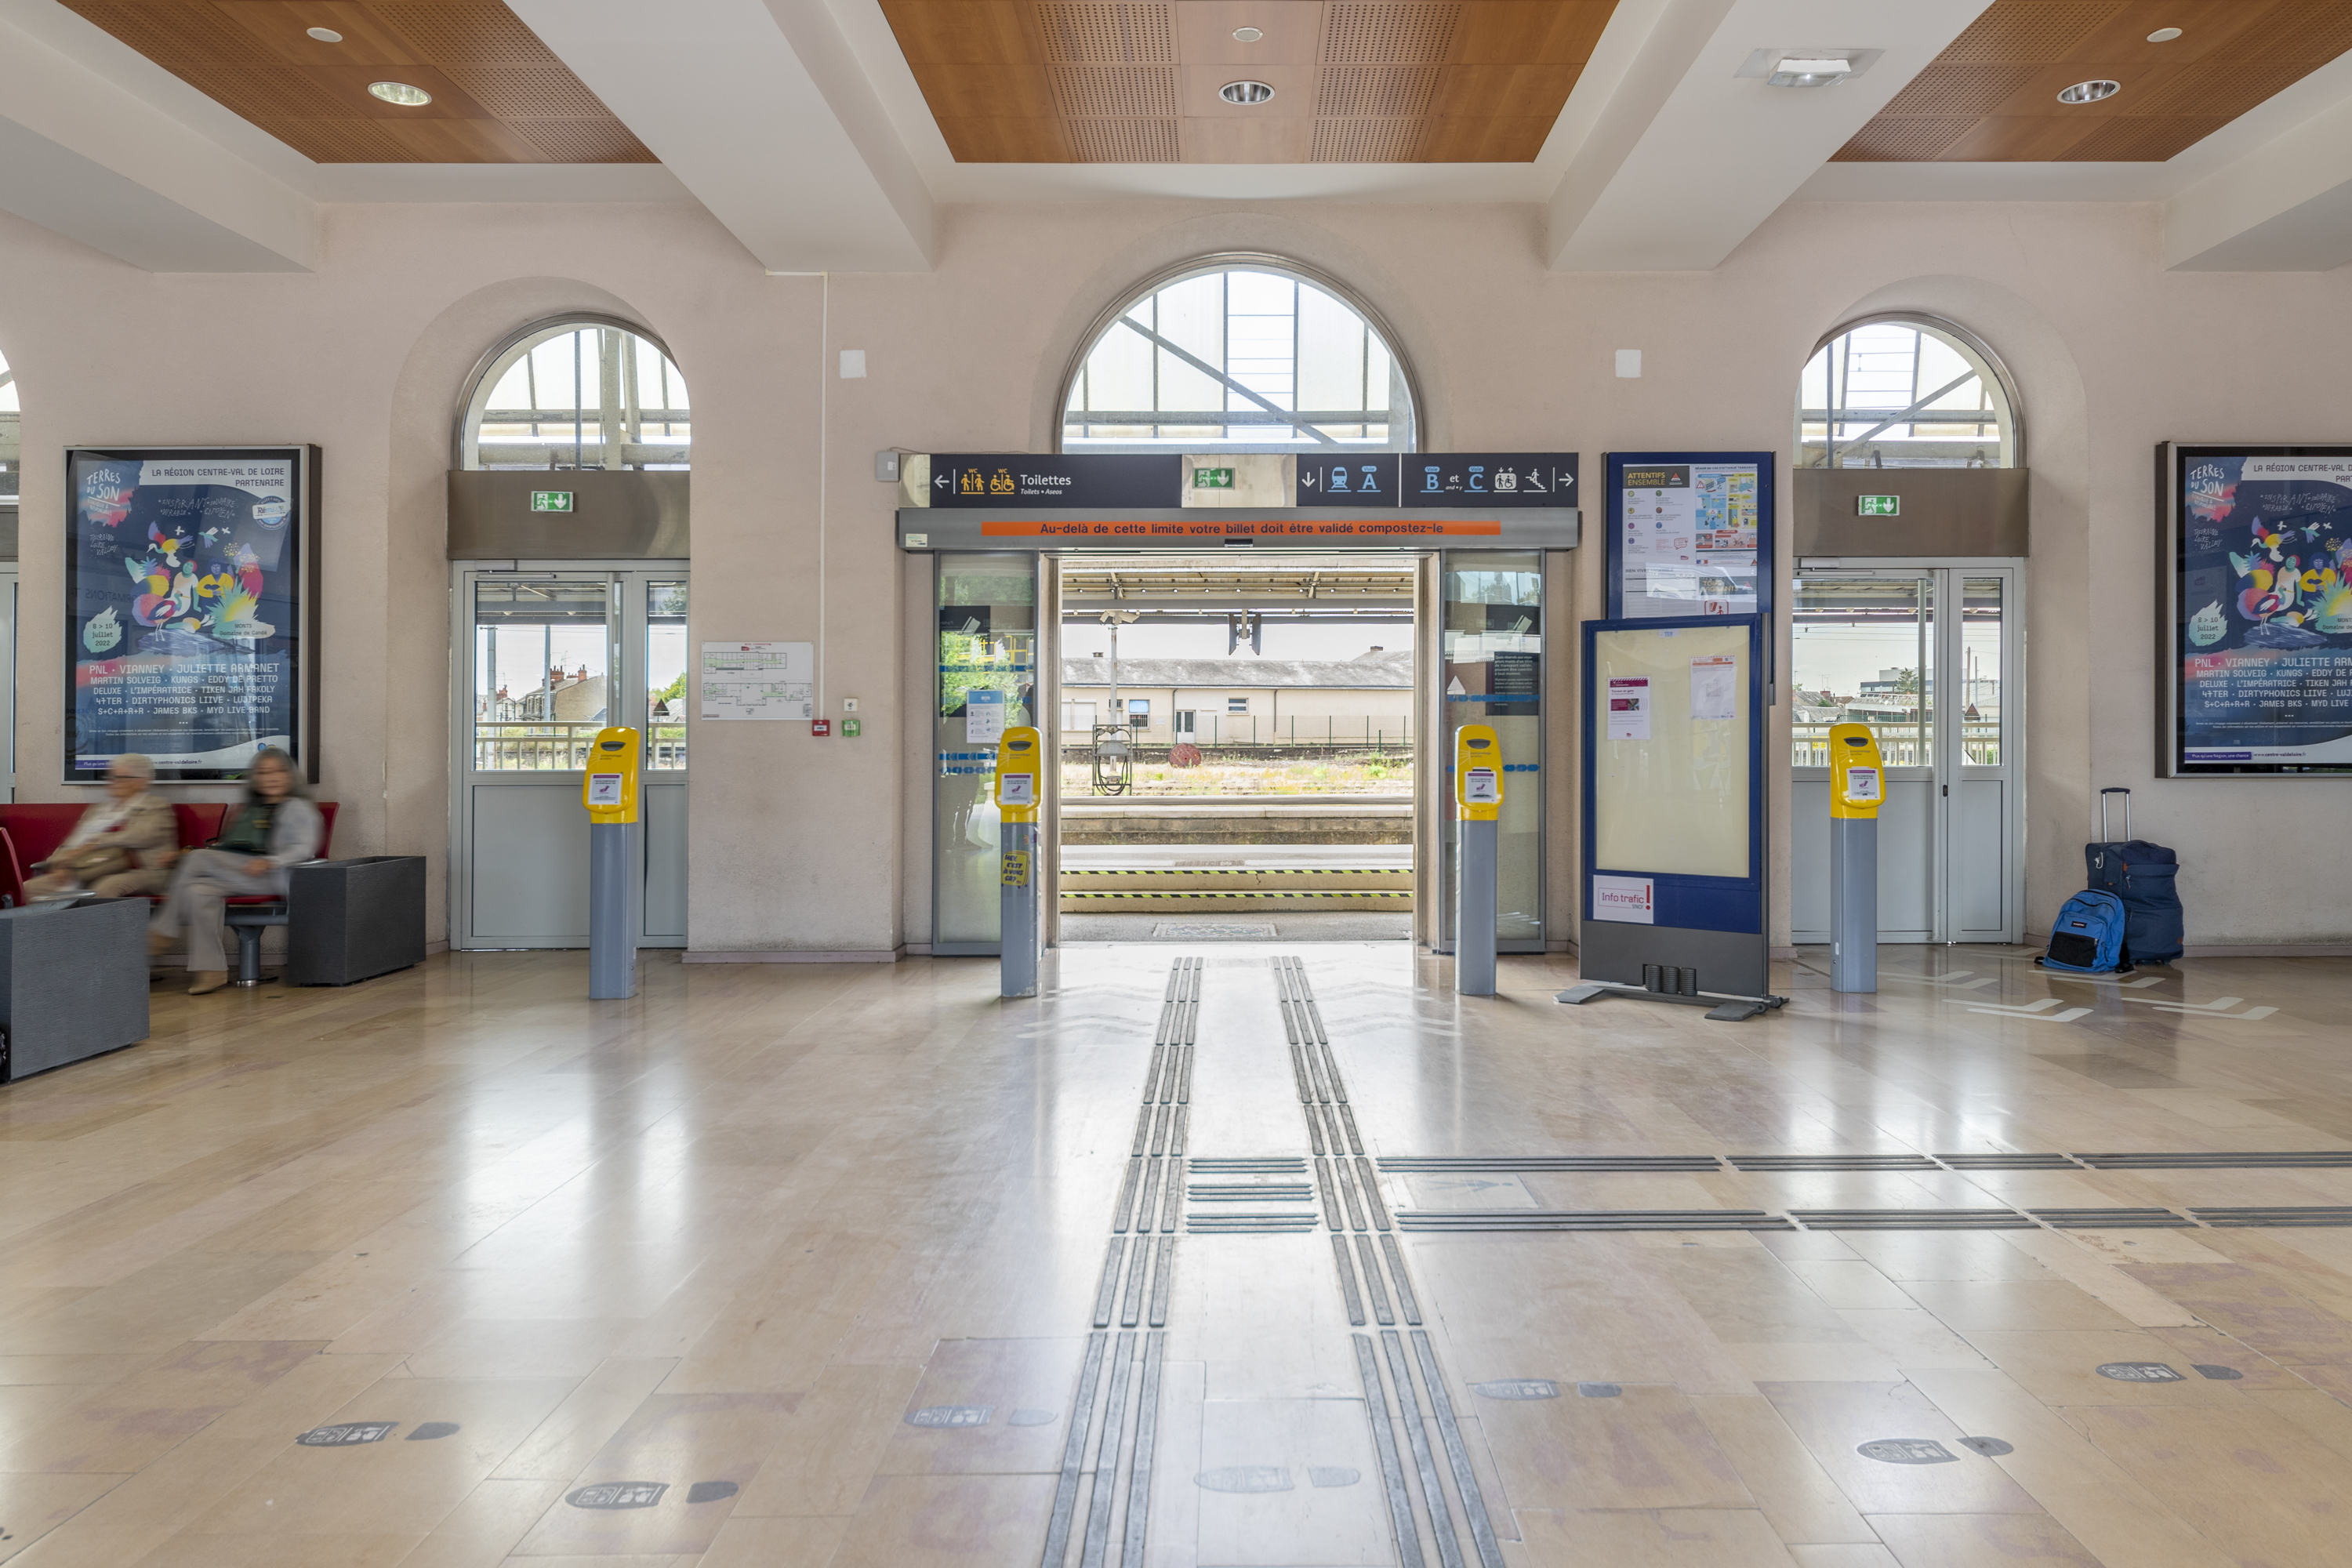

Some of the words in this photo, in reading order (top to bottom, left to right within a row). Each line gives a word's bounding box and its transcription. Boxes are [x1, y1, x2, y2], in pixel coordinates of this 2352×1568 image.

[164, 467, 194, 477] RÉGION
[2190, 463, 2224, 480] TERRES
[2267, 463, 2295, 472] RÉGION
[86, 468, 121, 485] TERRES
[1020, 474, 1071, 485] Toilettes
[1362, 474, 1377, 489] A
[1427, 474, 1439, 490] B
[1450, 474, 1459, 483] et
[1470, 474, 1483, 490] C
[86, 486, 96, 495] DU
[96, 484, 119, 501] SON
[2201, 478, 2223, 496] SON
[162, 497, 208, 510] INSPIRANT
[2264, 492, 2311, 505] INSPIRANT
[204, 507, 232, 519] CITOYEN
[2306, 503, 2334, 514] CITOYEN
[1040, 523, 1088, 534] Au-delà
[1094, 523, 1109, 534] de
[1114, 524, 1146, 534] cette
[1152, 524, 1184, 534] limite
[1190, 524, 1221, 534] votre
[1225, 523, 1255, 534] billet
[1261, 523, 1283, 533] doit
[1290, 523, 1313, 533] être
[1319, 523, 1353, 533] validé
[1359, 523, 1443, 535] compostez-le
[89, 665, 108, 674] PNL
[119, 664, 165, 674] VIANNEY
[176, 663, 227, 673] JULIETTE
[230, 663, 280, 673] ARMANET
[2195, 659, 2214, 667] PNL
[2226, 658, 2270, 667] VIANNEY
[2281, 658, 2330, 666] JULIETTE
[126, 676, 162, 684] SOLVEIG
[1602, 892, 1619, 902] Info
[1621, 894, 1644, 904] trafic
